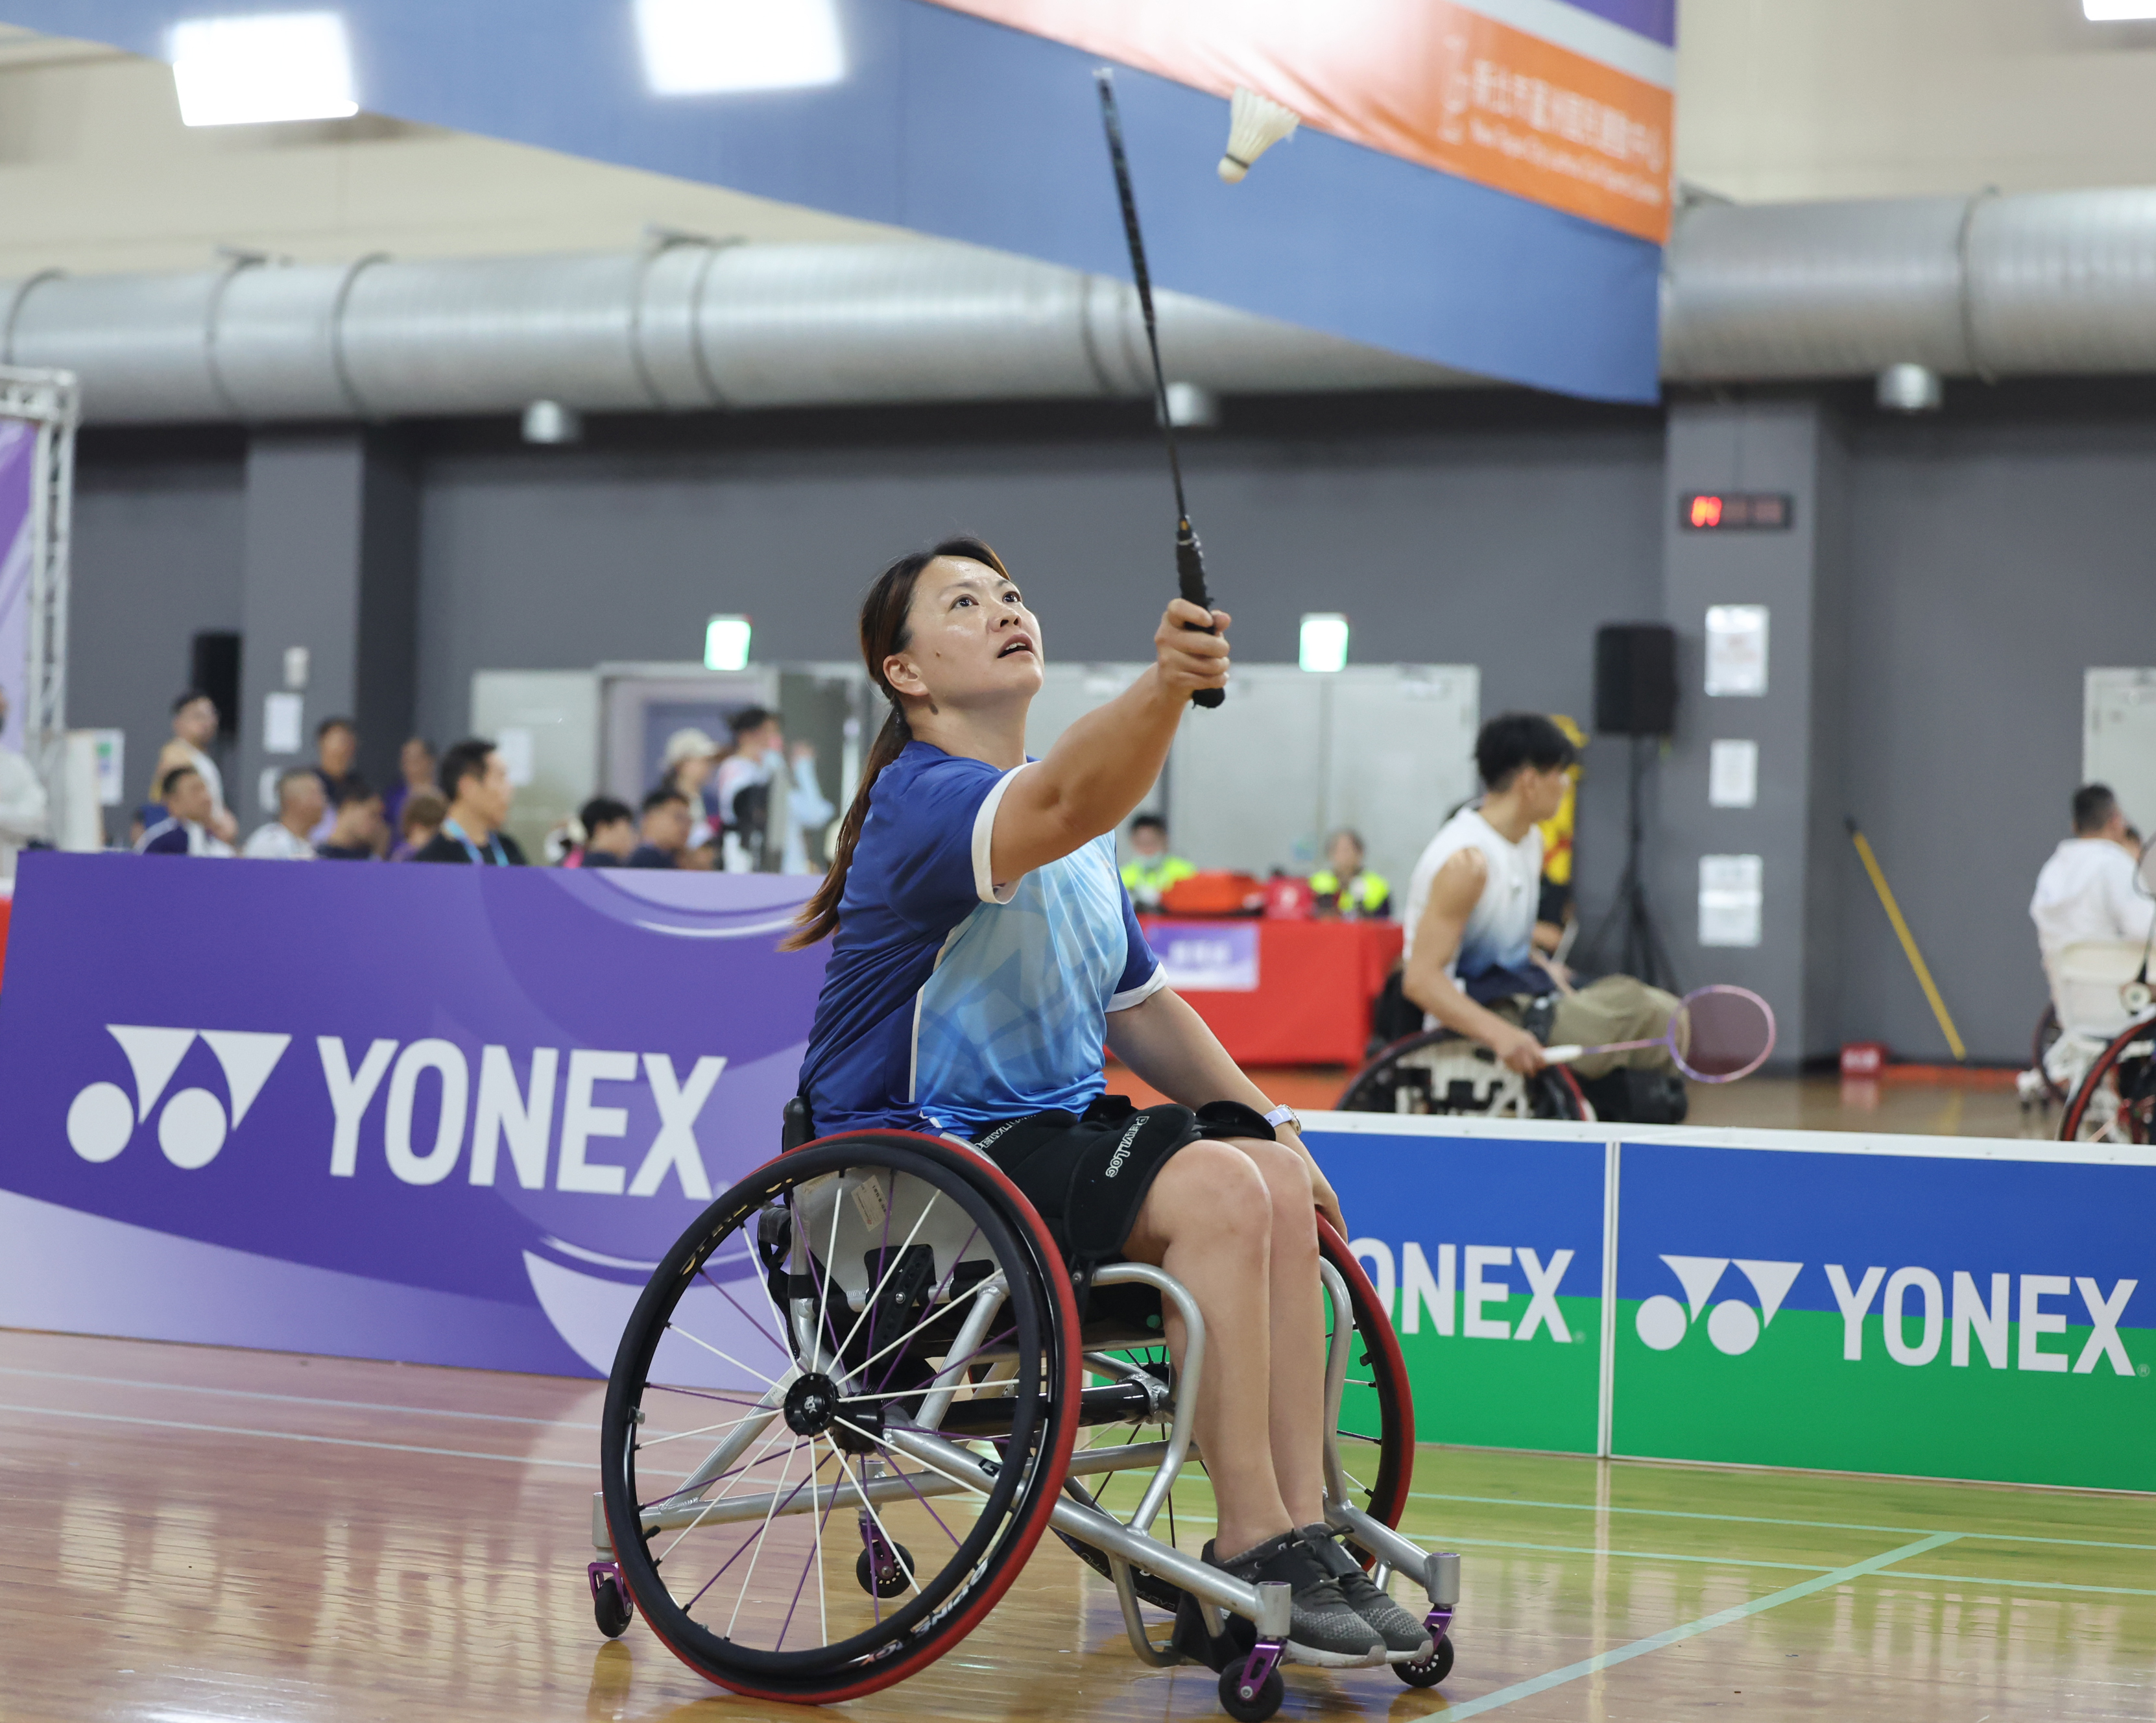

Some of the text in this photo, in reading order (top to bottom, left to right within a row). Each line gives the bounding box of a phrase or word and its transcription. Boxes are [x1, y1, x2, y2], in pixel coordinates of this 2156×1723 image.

[316, 1035, 728, 1201] YONEX
[1348, 1237, 1575, 1343] ONEX
[1823, 1263, 2138, 1377] YONEX
